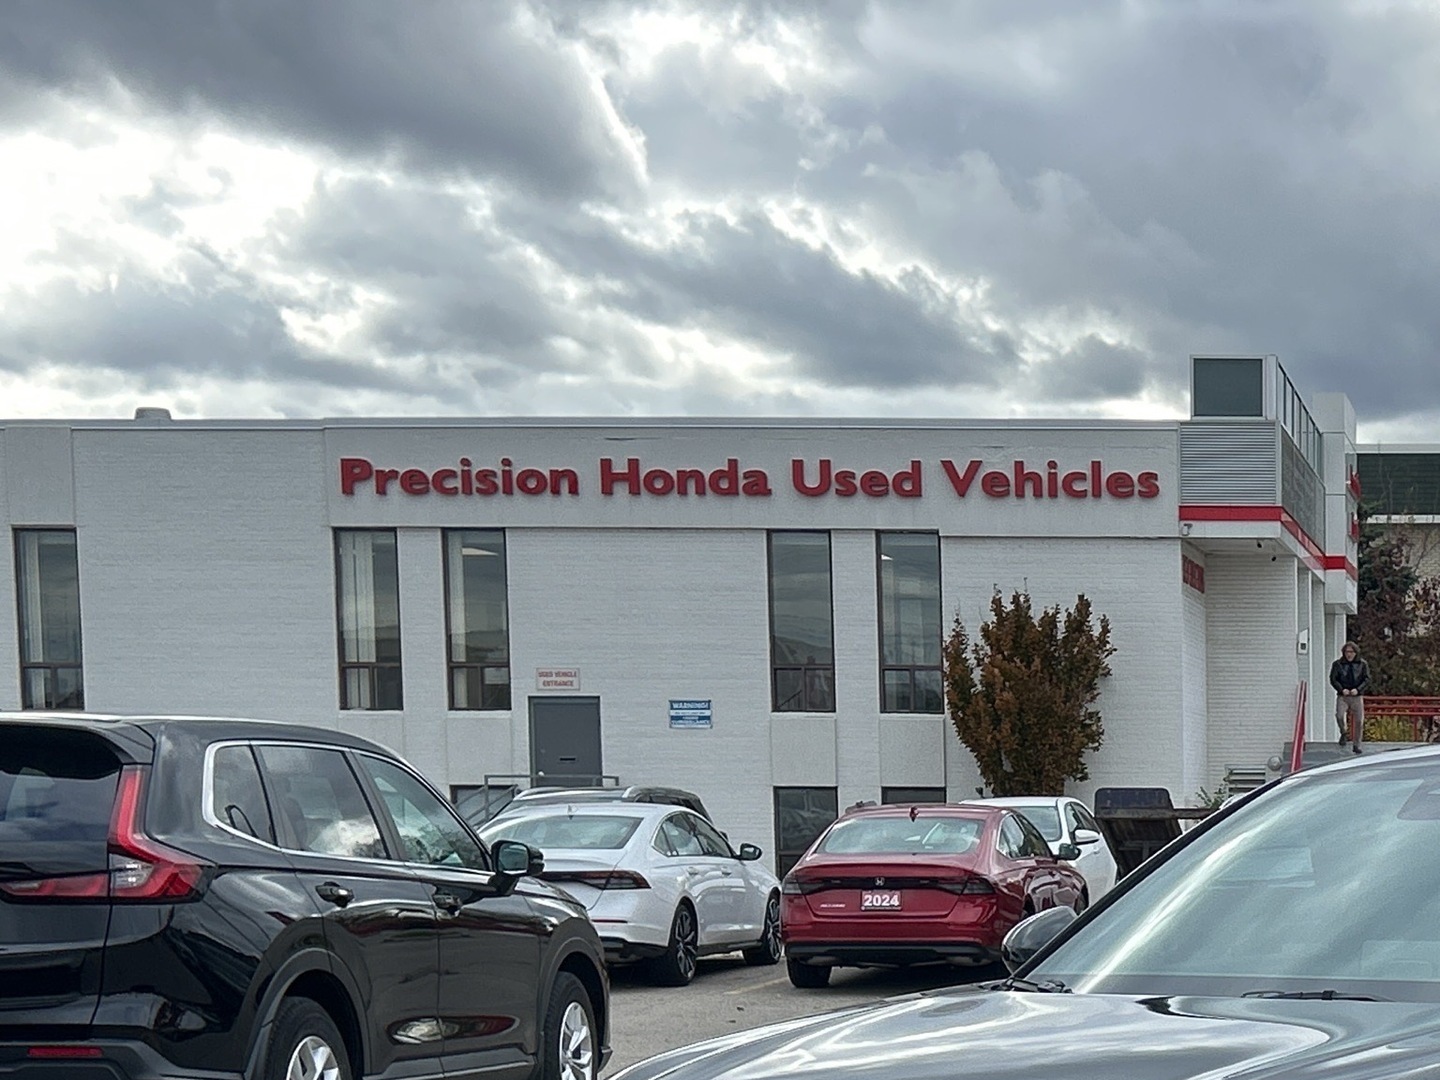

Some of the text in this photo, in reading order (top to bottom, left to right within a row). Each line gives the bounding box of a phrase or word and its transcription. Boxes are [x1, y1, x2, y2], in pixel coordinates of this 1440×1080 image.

[340, 457, 1160, 500] Precision Honda Used Vehicles
[863, 894, 900, 907] 2024
